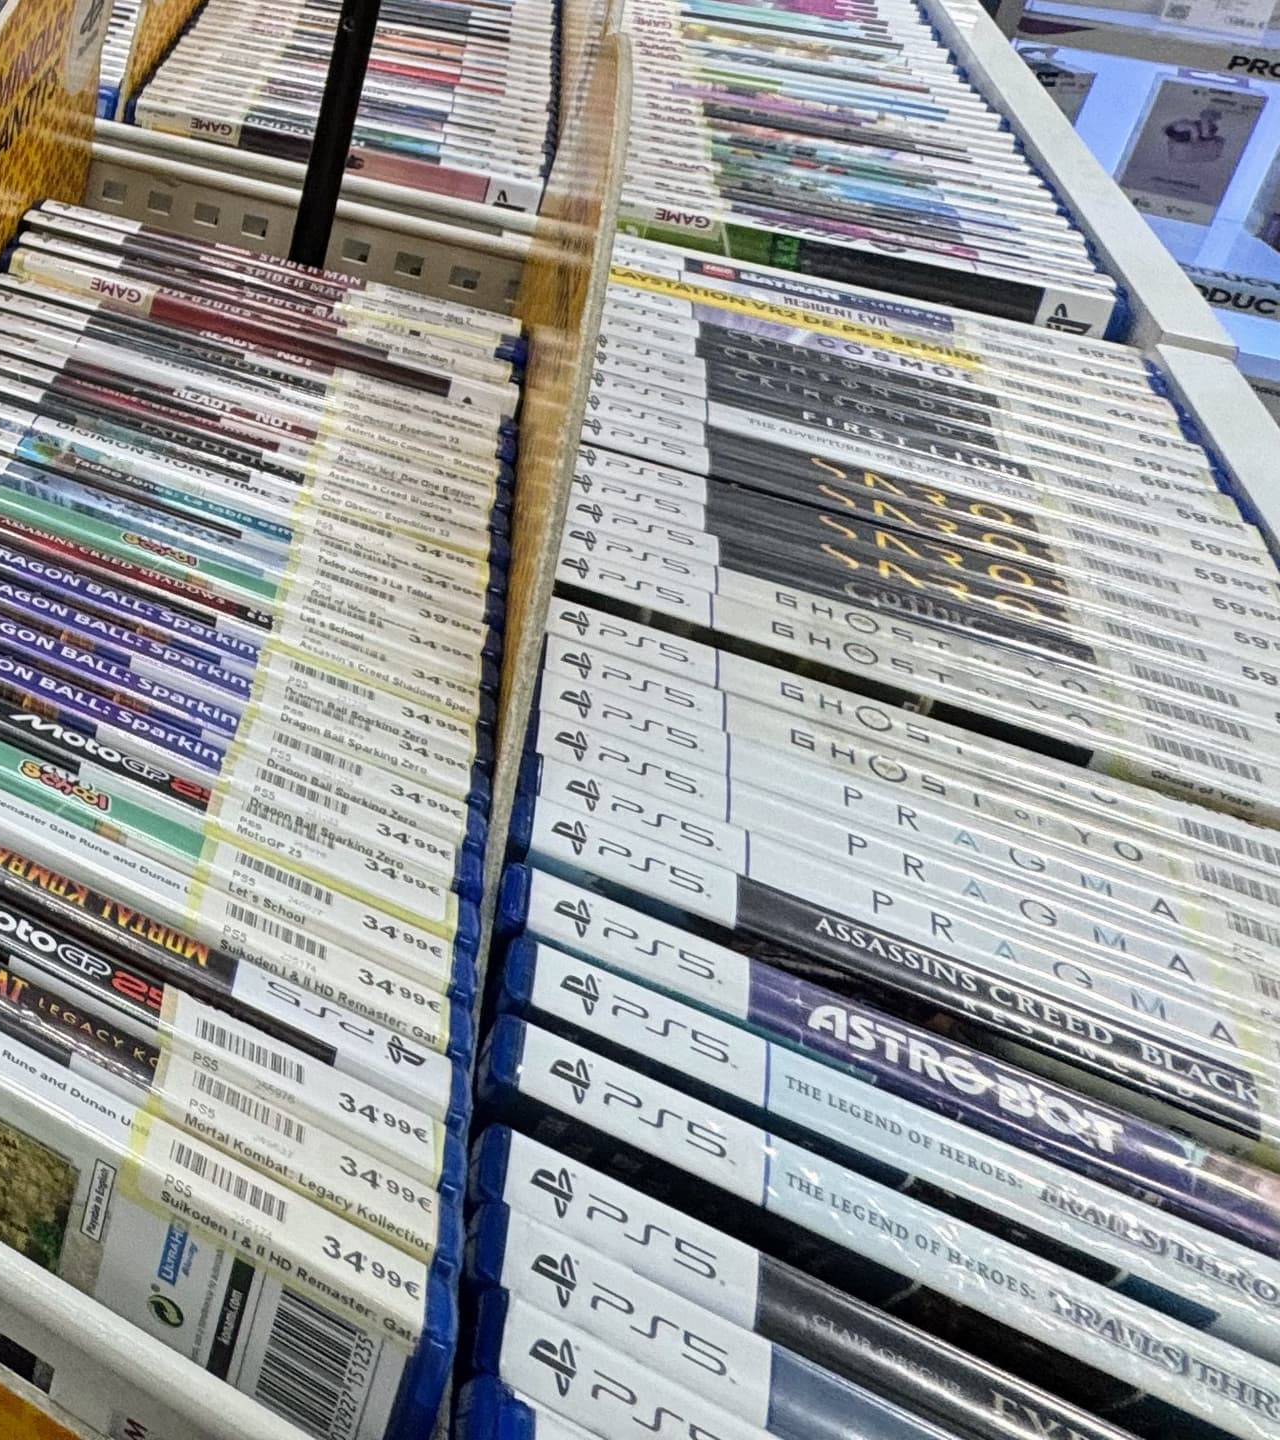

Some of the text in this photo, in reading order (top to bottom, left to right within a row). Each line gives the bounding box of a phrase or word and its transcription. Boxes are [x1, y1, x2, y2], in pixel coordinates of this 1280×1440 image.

[86, 583, 153, 616] BALL:
[38, 674, 111, 716] BALL:
[603, 917, 715, 980] PS5
[37, 999, 124, 1055] LEGACY
[989, 984, 1115, 1048] CREED
[1138, 1040, 1260, 1106] BLACK
[1, 1046, 38, 1075] Rune
[38, 1068, 68, 1091] and
[69, 1085, 119, 1120] Dunan
[806, 1004, 1125, 1155] ASTRO BOT
[784, 1074, 1024, 1189] THE LEGEND OF HEROES:
[160, 1190, 228, 1238] Suikoden
[164, 1173, 193, 1198] PS5
[298, 1169, 353, 1210] Legacy
[590, 1283, 730, 1379] PS5
